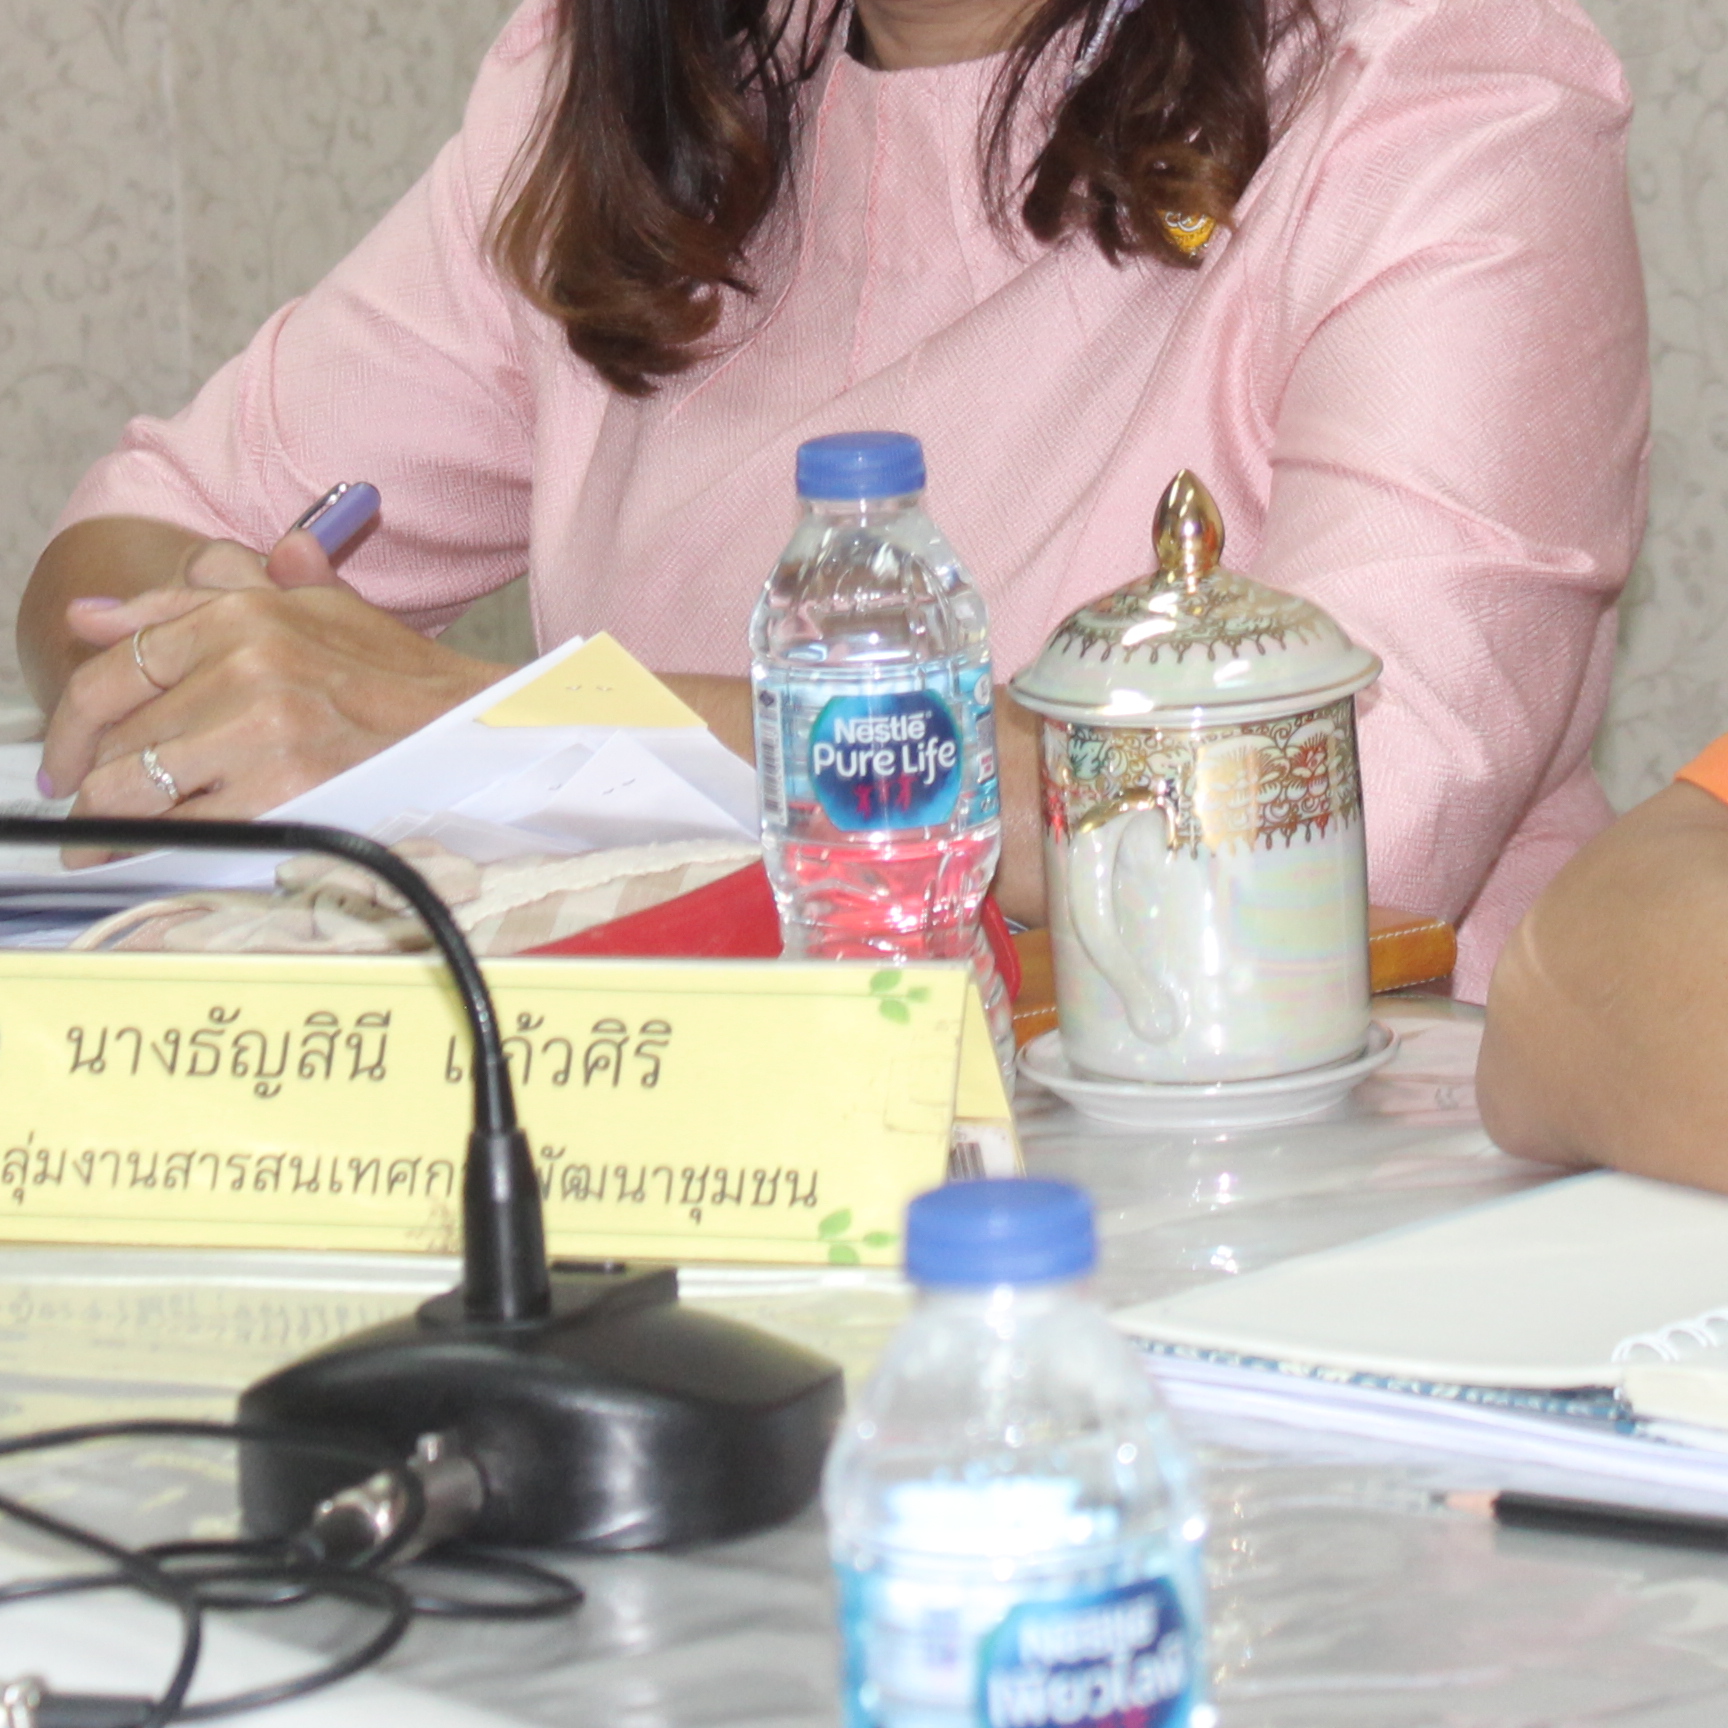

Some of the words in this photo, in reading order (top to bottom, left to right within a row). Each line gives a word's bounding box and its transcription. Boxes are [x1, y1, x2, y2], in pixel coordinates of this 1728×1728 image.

[813, 743, 895, 777] Pure
[902, 736, 956, 785] Life
[65, 1006, 393, 1100] นางธัญสินี
